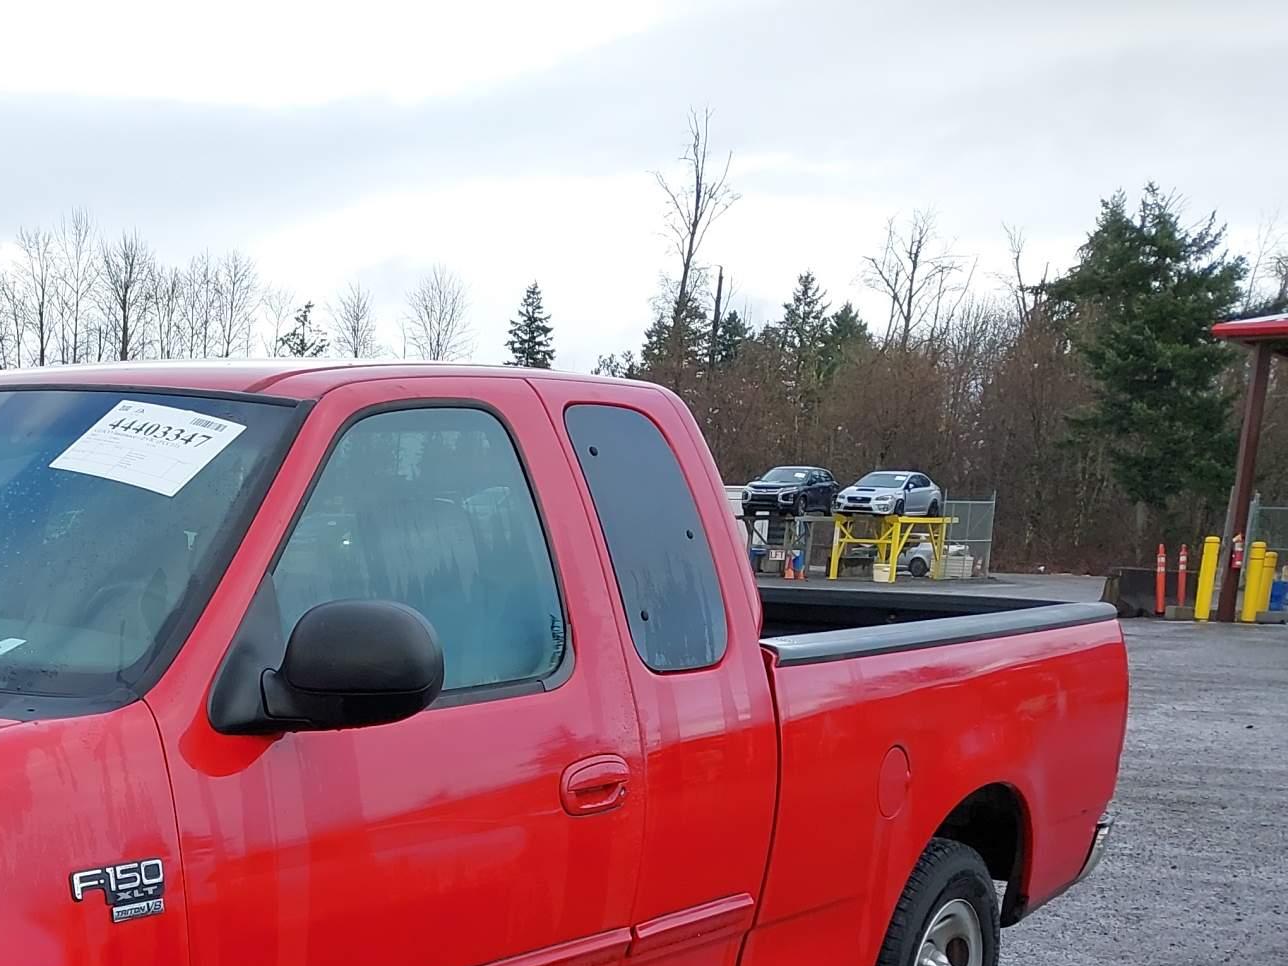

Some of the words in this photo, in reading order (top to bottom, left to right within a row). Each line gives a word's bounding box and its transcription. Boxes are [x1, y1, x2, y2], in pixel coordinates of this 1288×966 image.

[109, 417, 214, 448] 44403347
[116, 886, 157, 900] XLT
[115, 905, 146, 918] TRITON
[146, 900, 163, 914] V8
